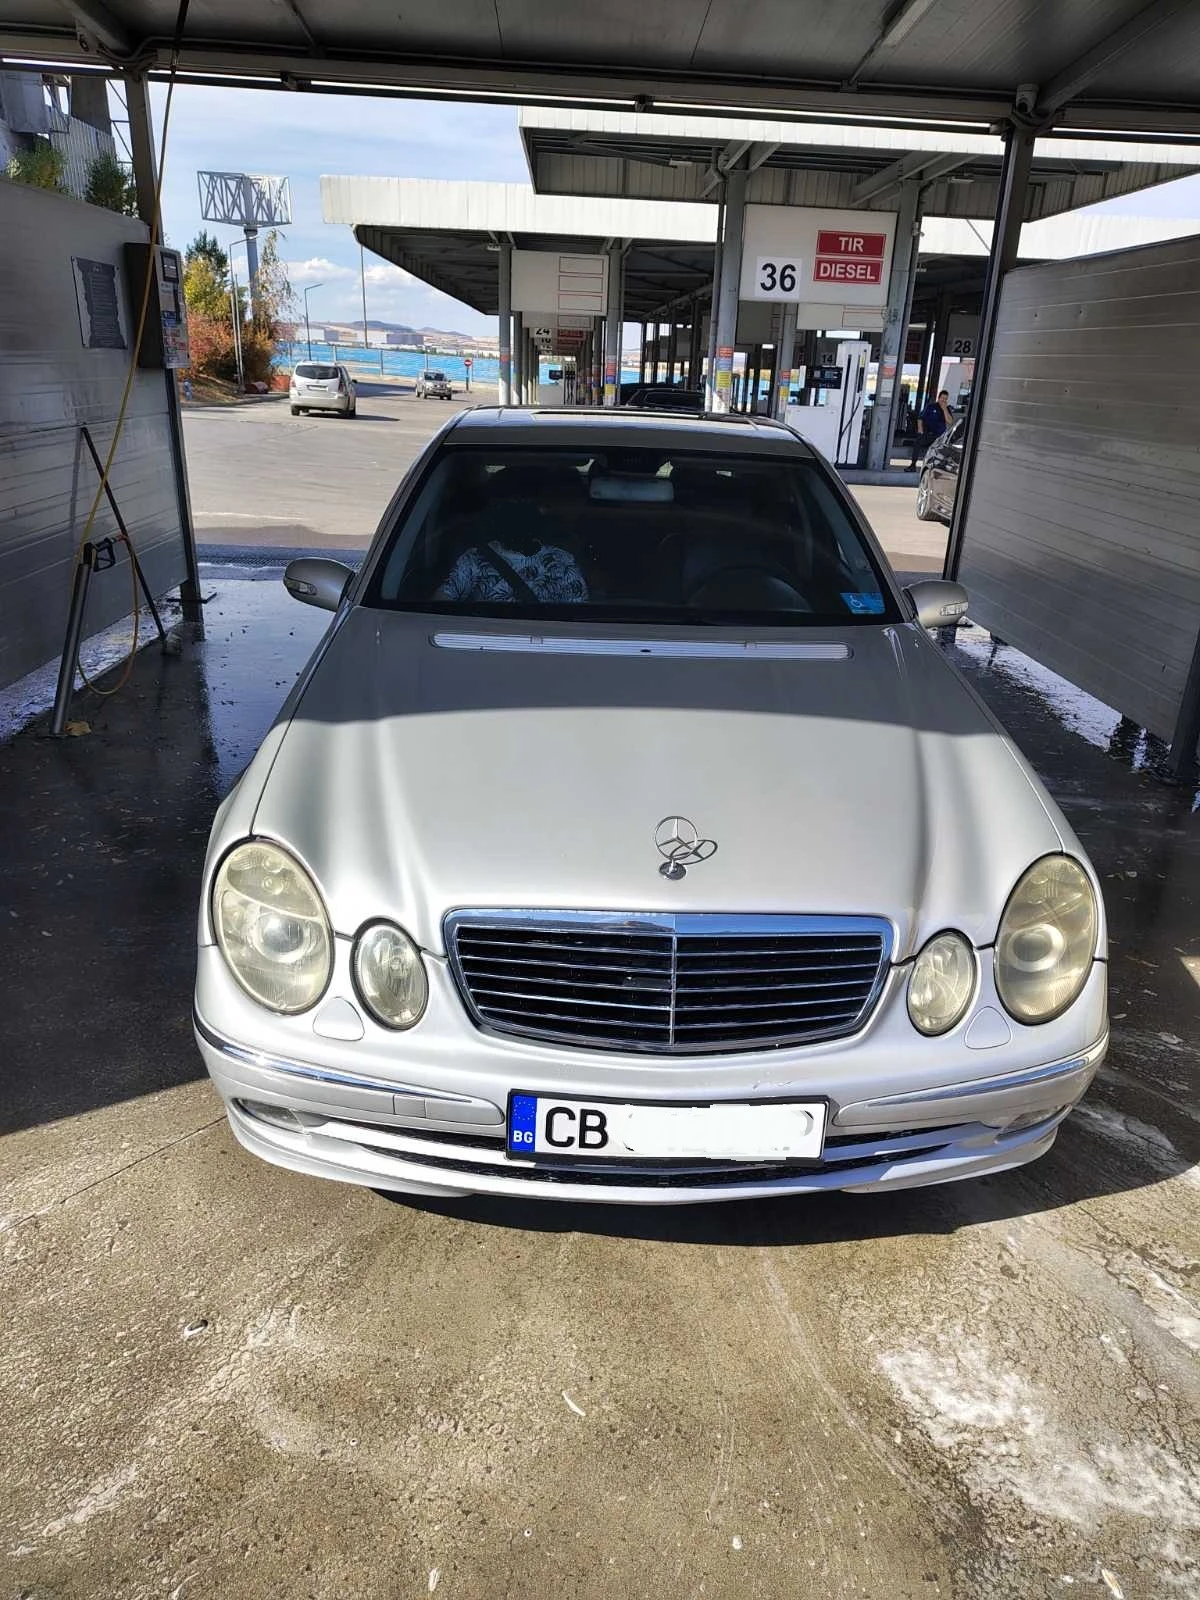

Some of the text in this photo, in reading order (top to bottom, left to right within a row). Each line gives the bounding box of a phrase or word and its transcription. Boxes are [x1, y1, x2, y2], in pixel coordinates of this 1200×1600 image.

[839, 237, 864, 252] TIR
[760, 263, 796, 292] 36
[819, 263, 876, 280] DIESEL
[954, 340, 972, 353] 28
[513, 1130, 533, 1143] BG
